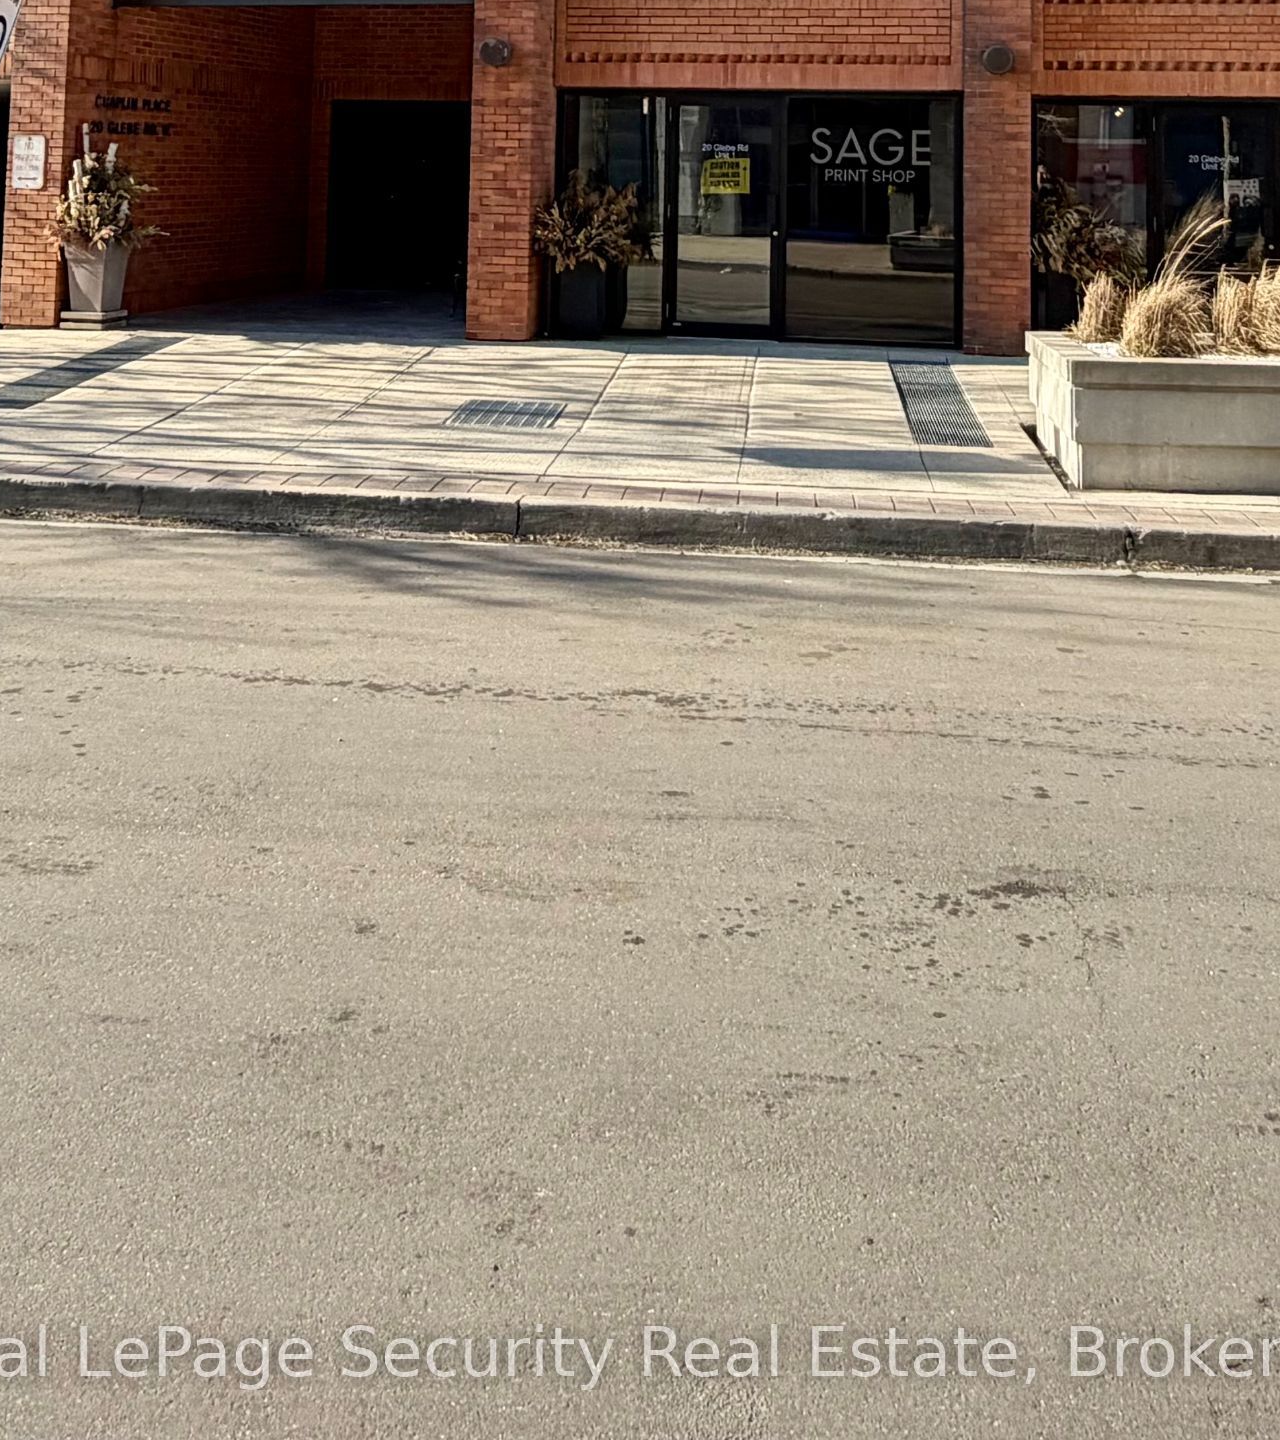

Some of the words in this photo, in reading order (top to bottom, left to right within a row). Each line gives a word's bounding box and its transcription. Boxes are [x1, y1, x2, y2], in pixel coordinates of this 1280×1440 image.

[90, 121, 103, 134] 20
[737, 144, 749, 152] Rd
[810, 128, 931, 165] SAGE
[1188, 155, 1199, 163] 20
[824, 168, 869, 182] PRINT
[872, 169, 916, 183] SHOP
